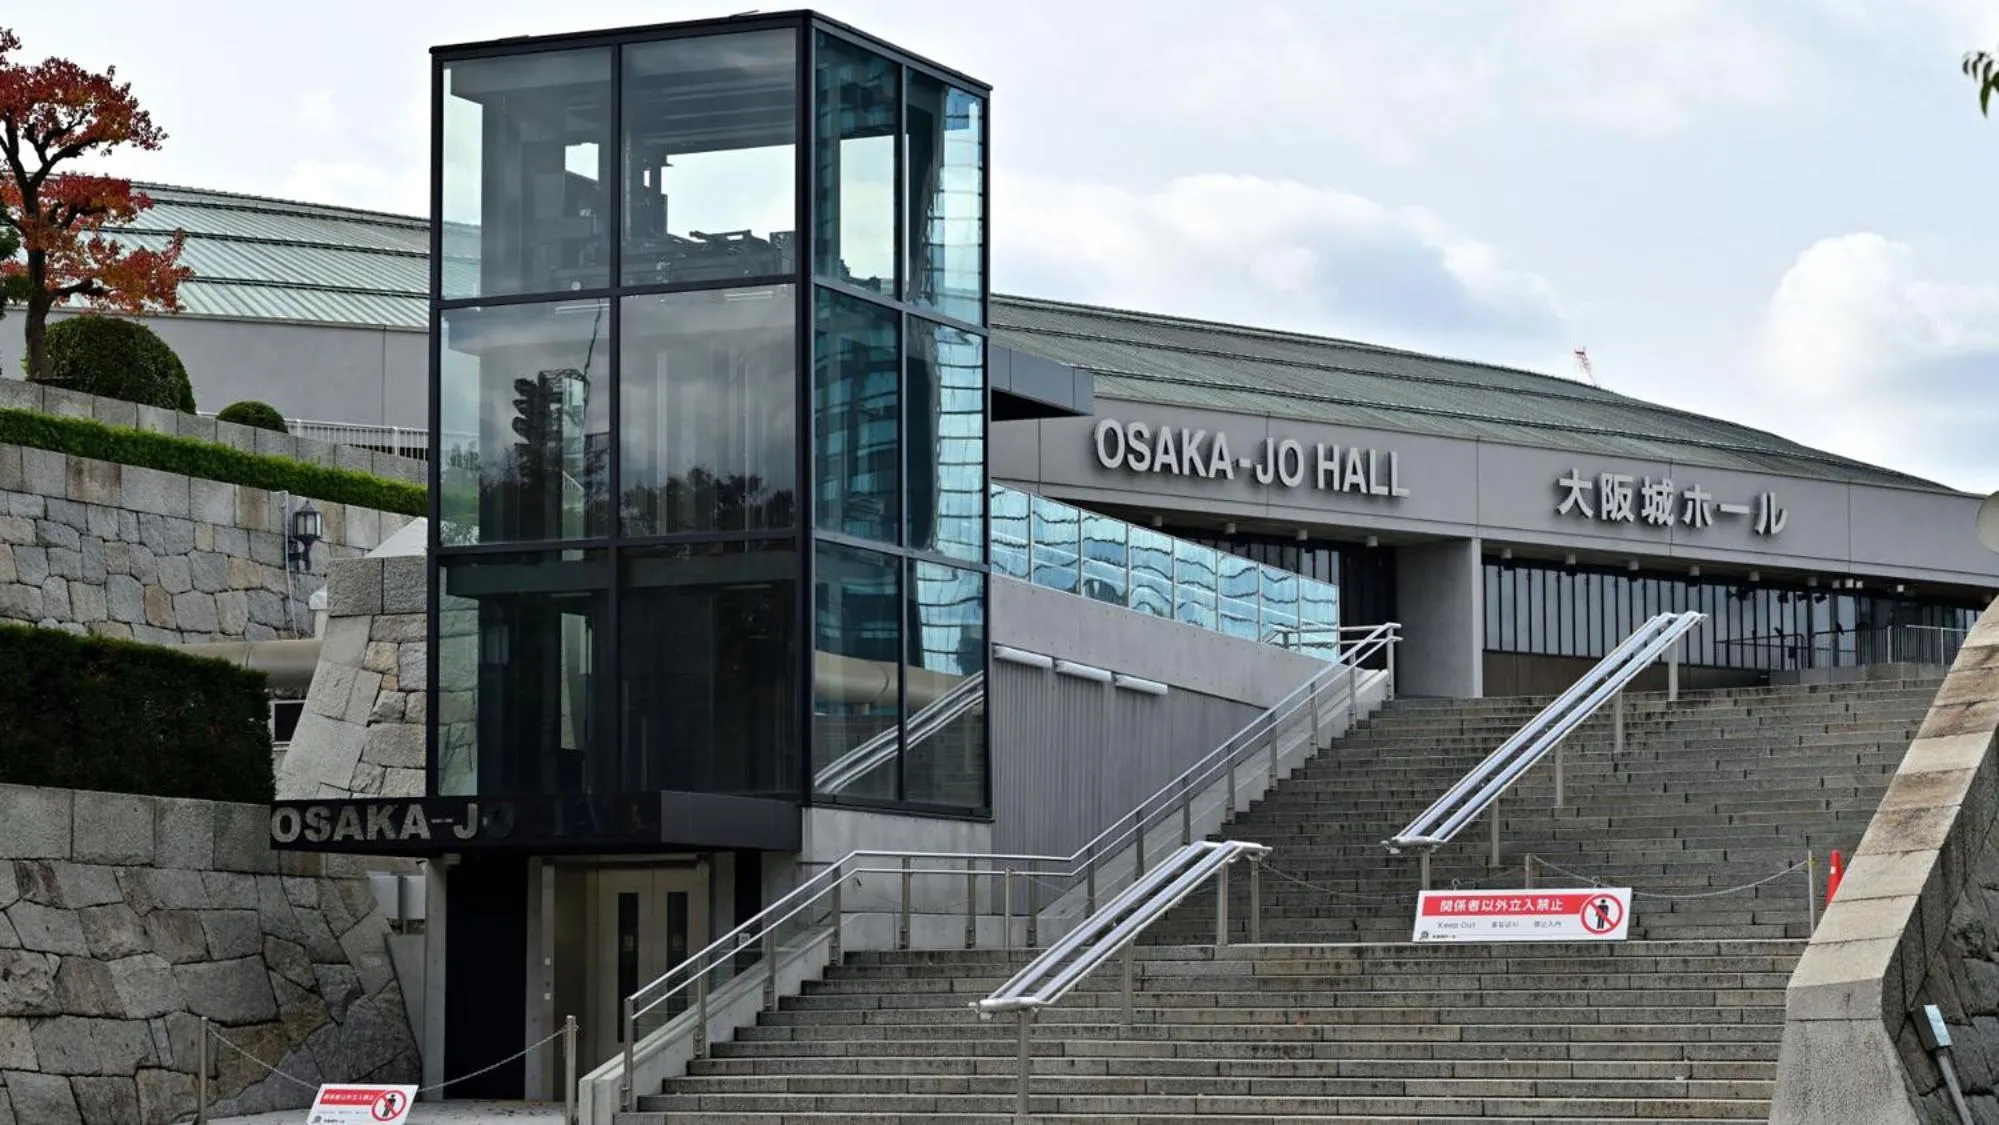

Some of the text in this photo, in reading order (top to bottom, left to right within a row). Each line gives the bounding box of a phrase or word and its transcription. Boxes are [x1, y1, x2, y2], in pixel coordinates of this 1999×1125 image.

[1096, 418, 1410, 498] OSAKA-JO HALL
[1555, 467, 1788, 536] 大阪城ホール
[1440, 898, 1564, 912] 関係者以外立入禁止
